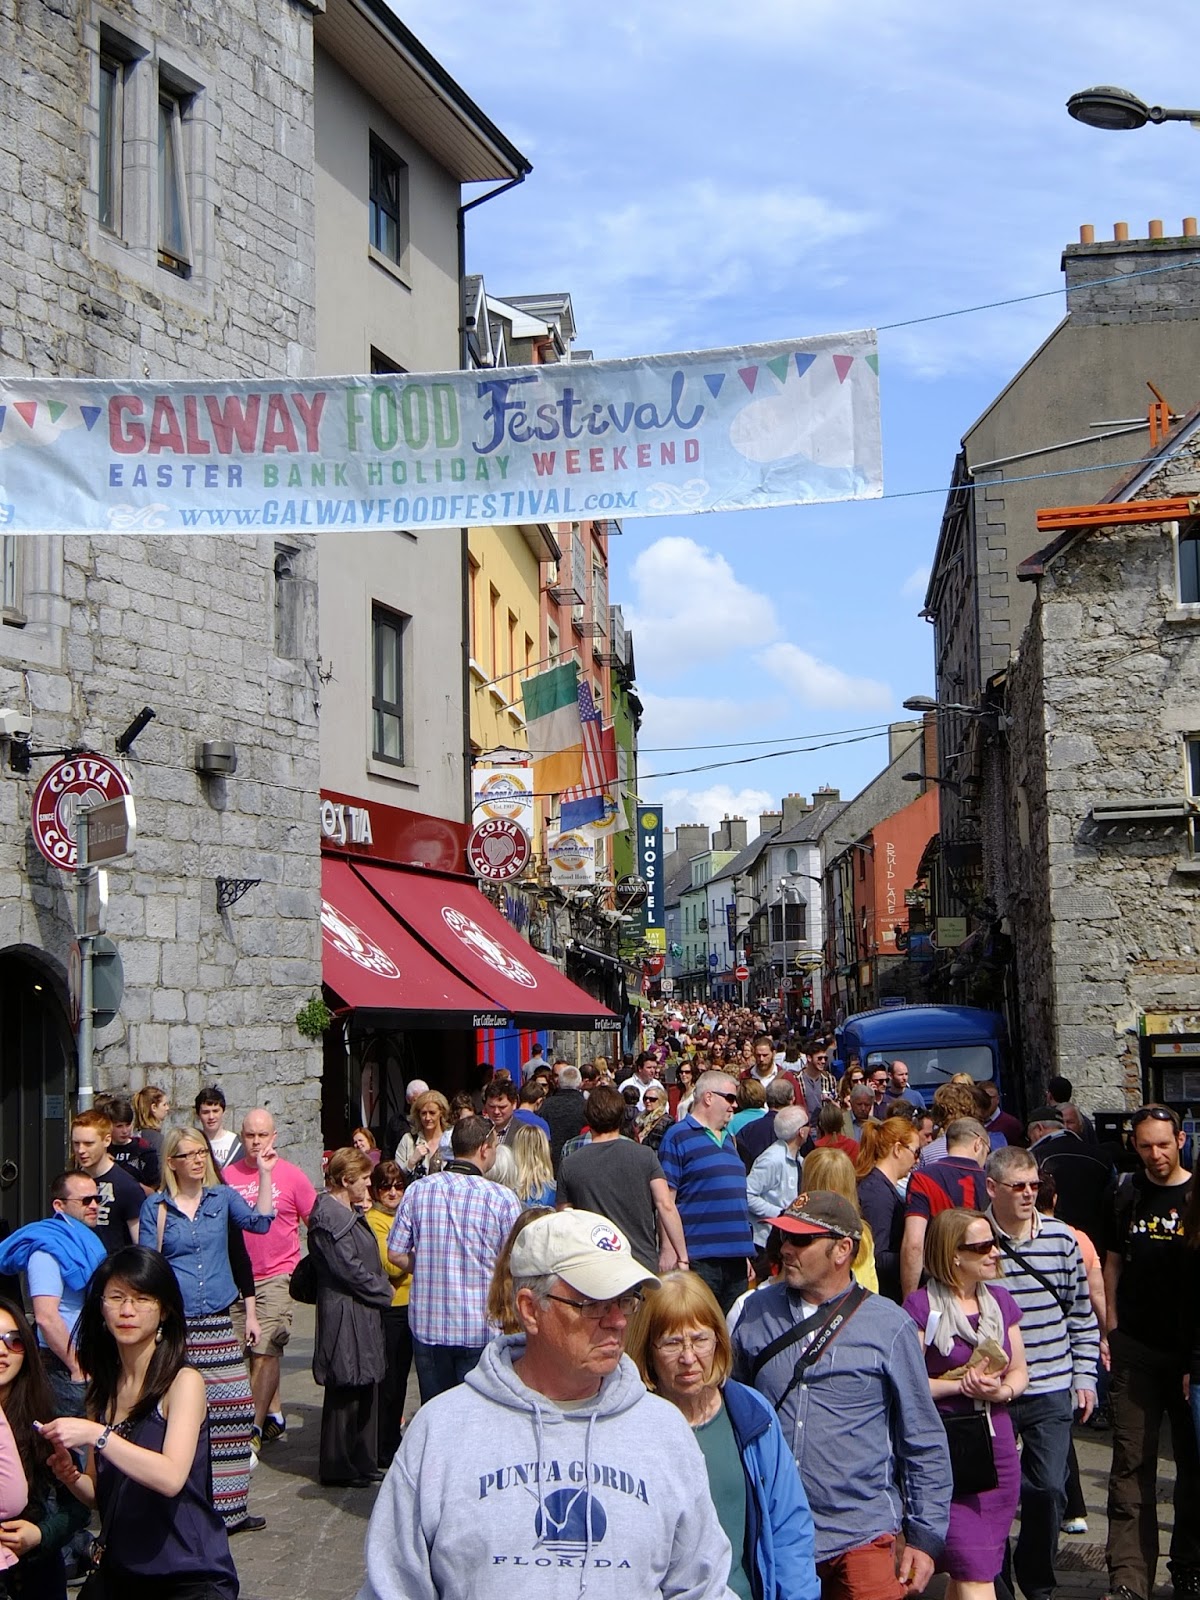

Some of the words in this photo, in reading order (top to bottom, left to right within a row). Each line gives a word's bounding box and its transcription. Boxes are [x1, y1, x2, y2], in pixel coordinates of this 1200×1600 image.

[107, 391, 327, 455] GALWAY
[346, 382, 459, 452] FOOD
[472, 370, 705, 455] Festival
[109, 463, 243, 488] EASTER
[263, 462, 349, 487] BANK
[368, 455, 510, 486] HOLIDAY
[532, 438, 701, 477] WEEKEND
[50, 762, 111, 793] COSTA
[321, 799, 374, 847] OSTA
[479, 821, 518, 838] COSTA
[44, 829, 78, 864] COF
[885, 842, 897, 879] DRUID
[474, 857, 523, 878] COFFEE
[644, 835, 656, 923] HOSTEL
[617, 884, 647, 892] GUINNESS
[885, 882, 897, 915] LANE
[473, 1014, 481, 1027] For
[481, 1015, 495, 1027] Coffee
[829, 1314, 844, 1331] EOS
[808, 1329, 832, 1356] DIGITAL
[478, 1459, 562, 1501] PUNTA
[568, 1459, 650, 1506] GORDA
[492, 1555, 632, 1569] FLORIDA
